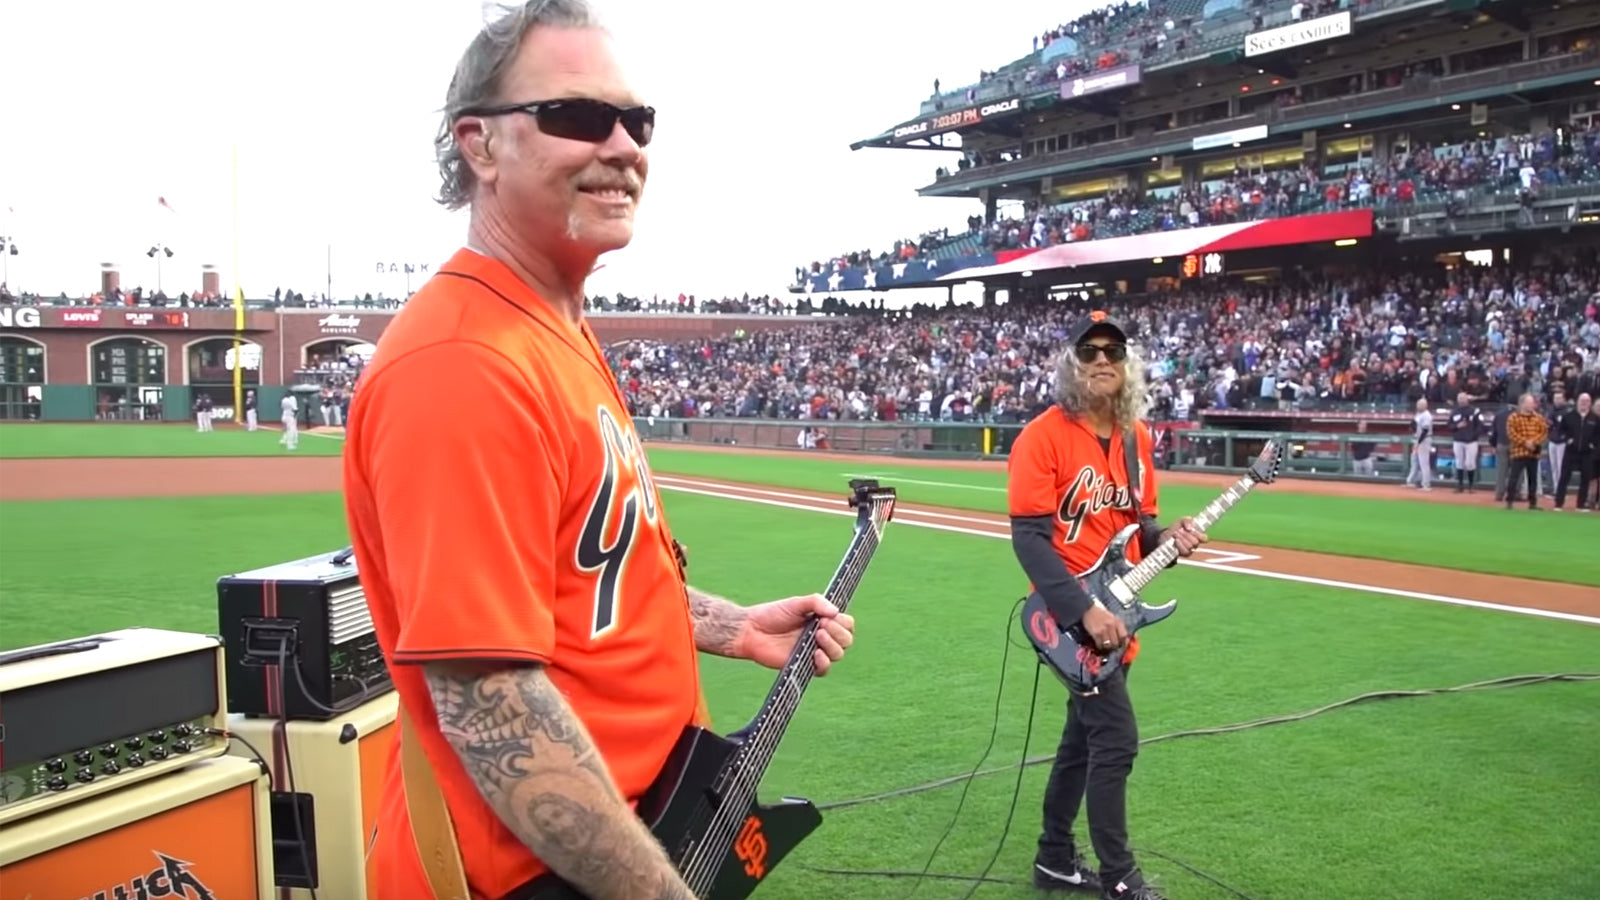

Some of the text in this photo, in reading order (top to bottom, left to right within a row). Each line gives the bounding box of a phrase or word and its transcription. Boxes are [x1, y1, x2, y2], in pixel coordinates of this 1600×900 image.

[895, 98, 1020, 138] ORACLE 7:03:07 PM ORACLE
[376, 262, 429, 273] BANK
[211, 407, 235, 419] 309
[1058, 464, 1145, 545] Gian
